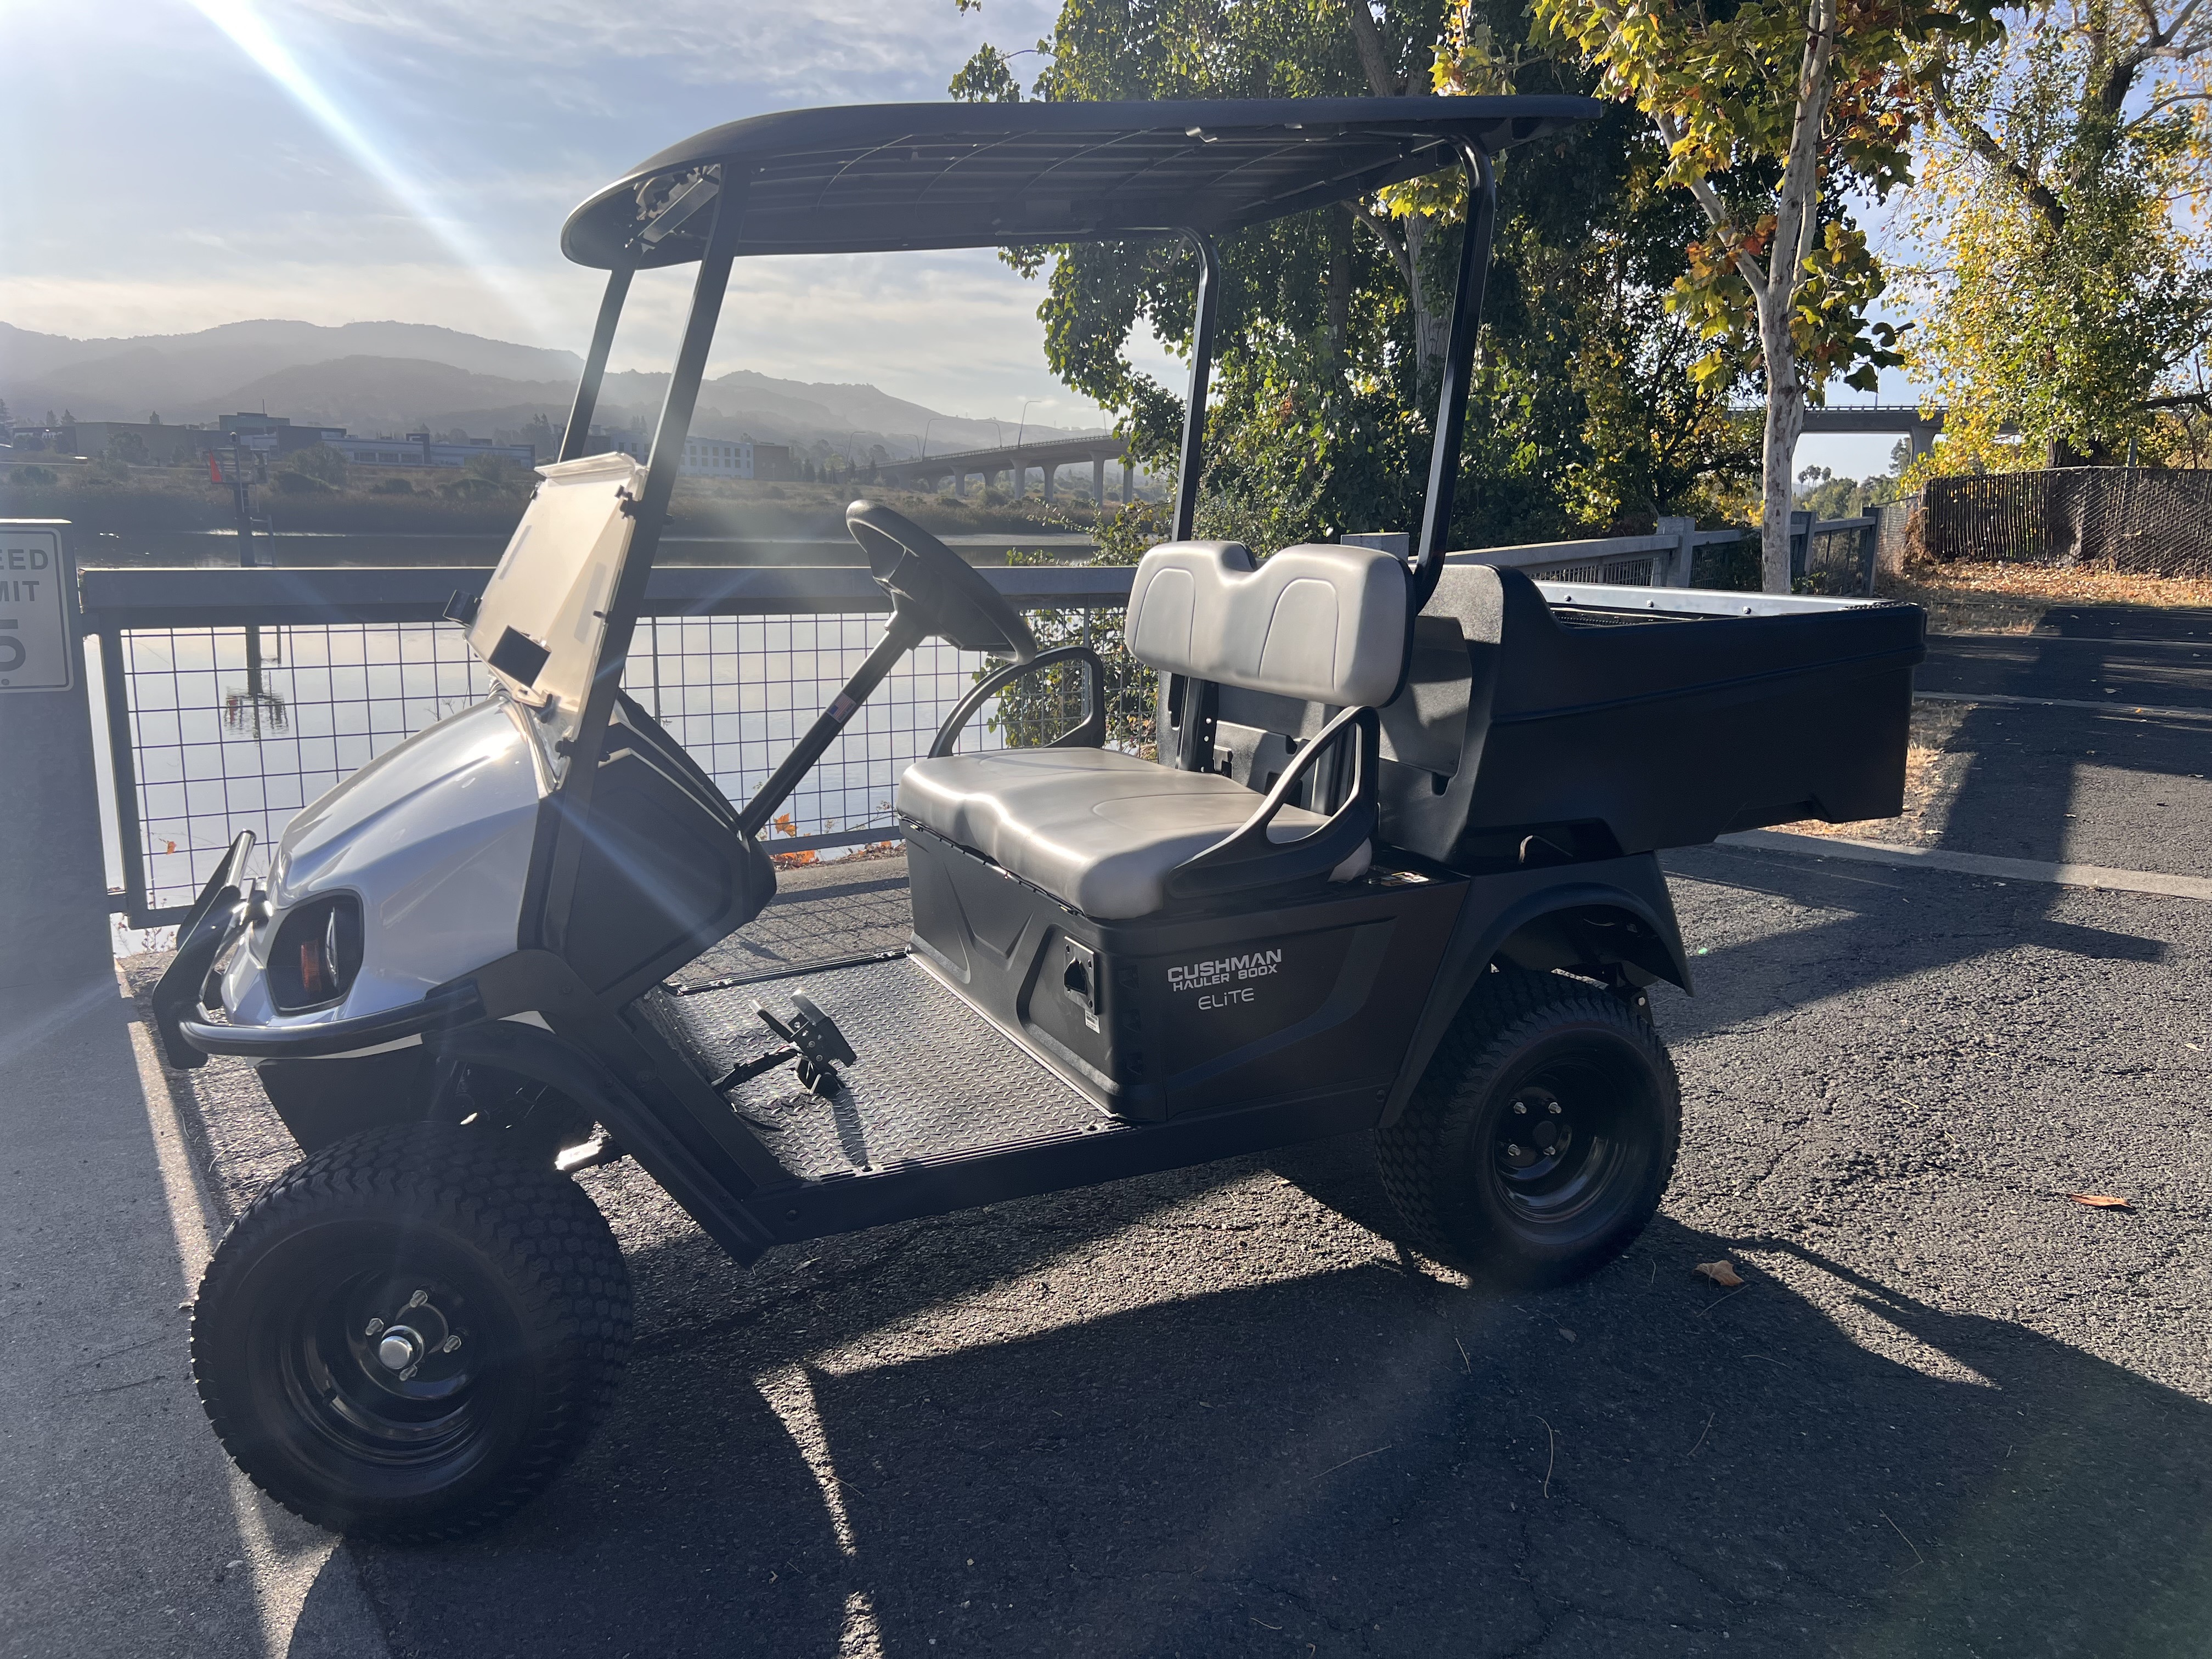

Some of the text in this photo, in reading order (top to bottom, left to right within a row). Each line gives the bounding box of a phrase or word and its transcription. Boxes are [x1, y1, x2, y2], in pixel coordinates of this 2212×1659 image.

[0, 549, 48, 570] ED
[1167, 949, 1282, 983] CUSHMAN
[1172, 963, 1278, 992] HAULER 800X
